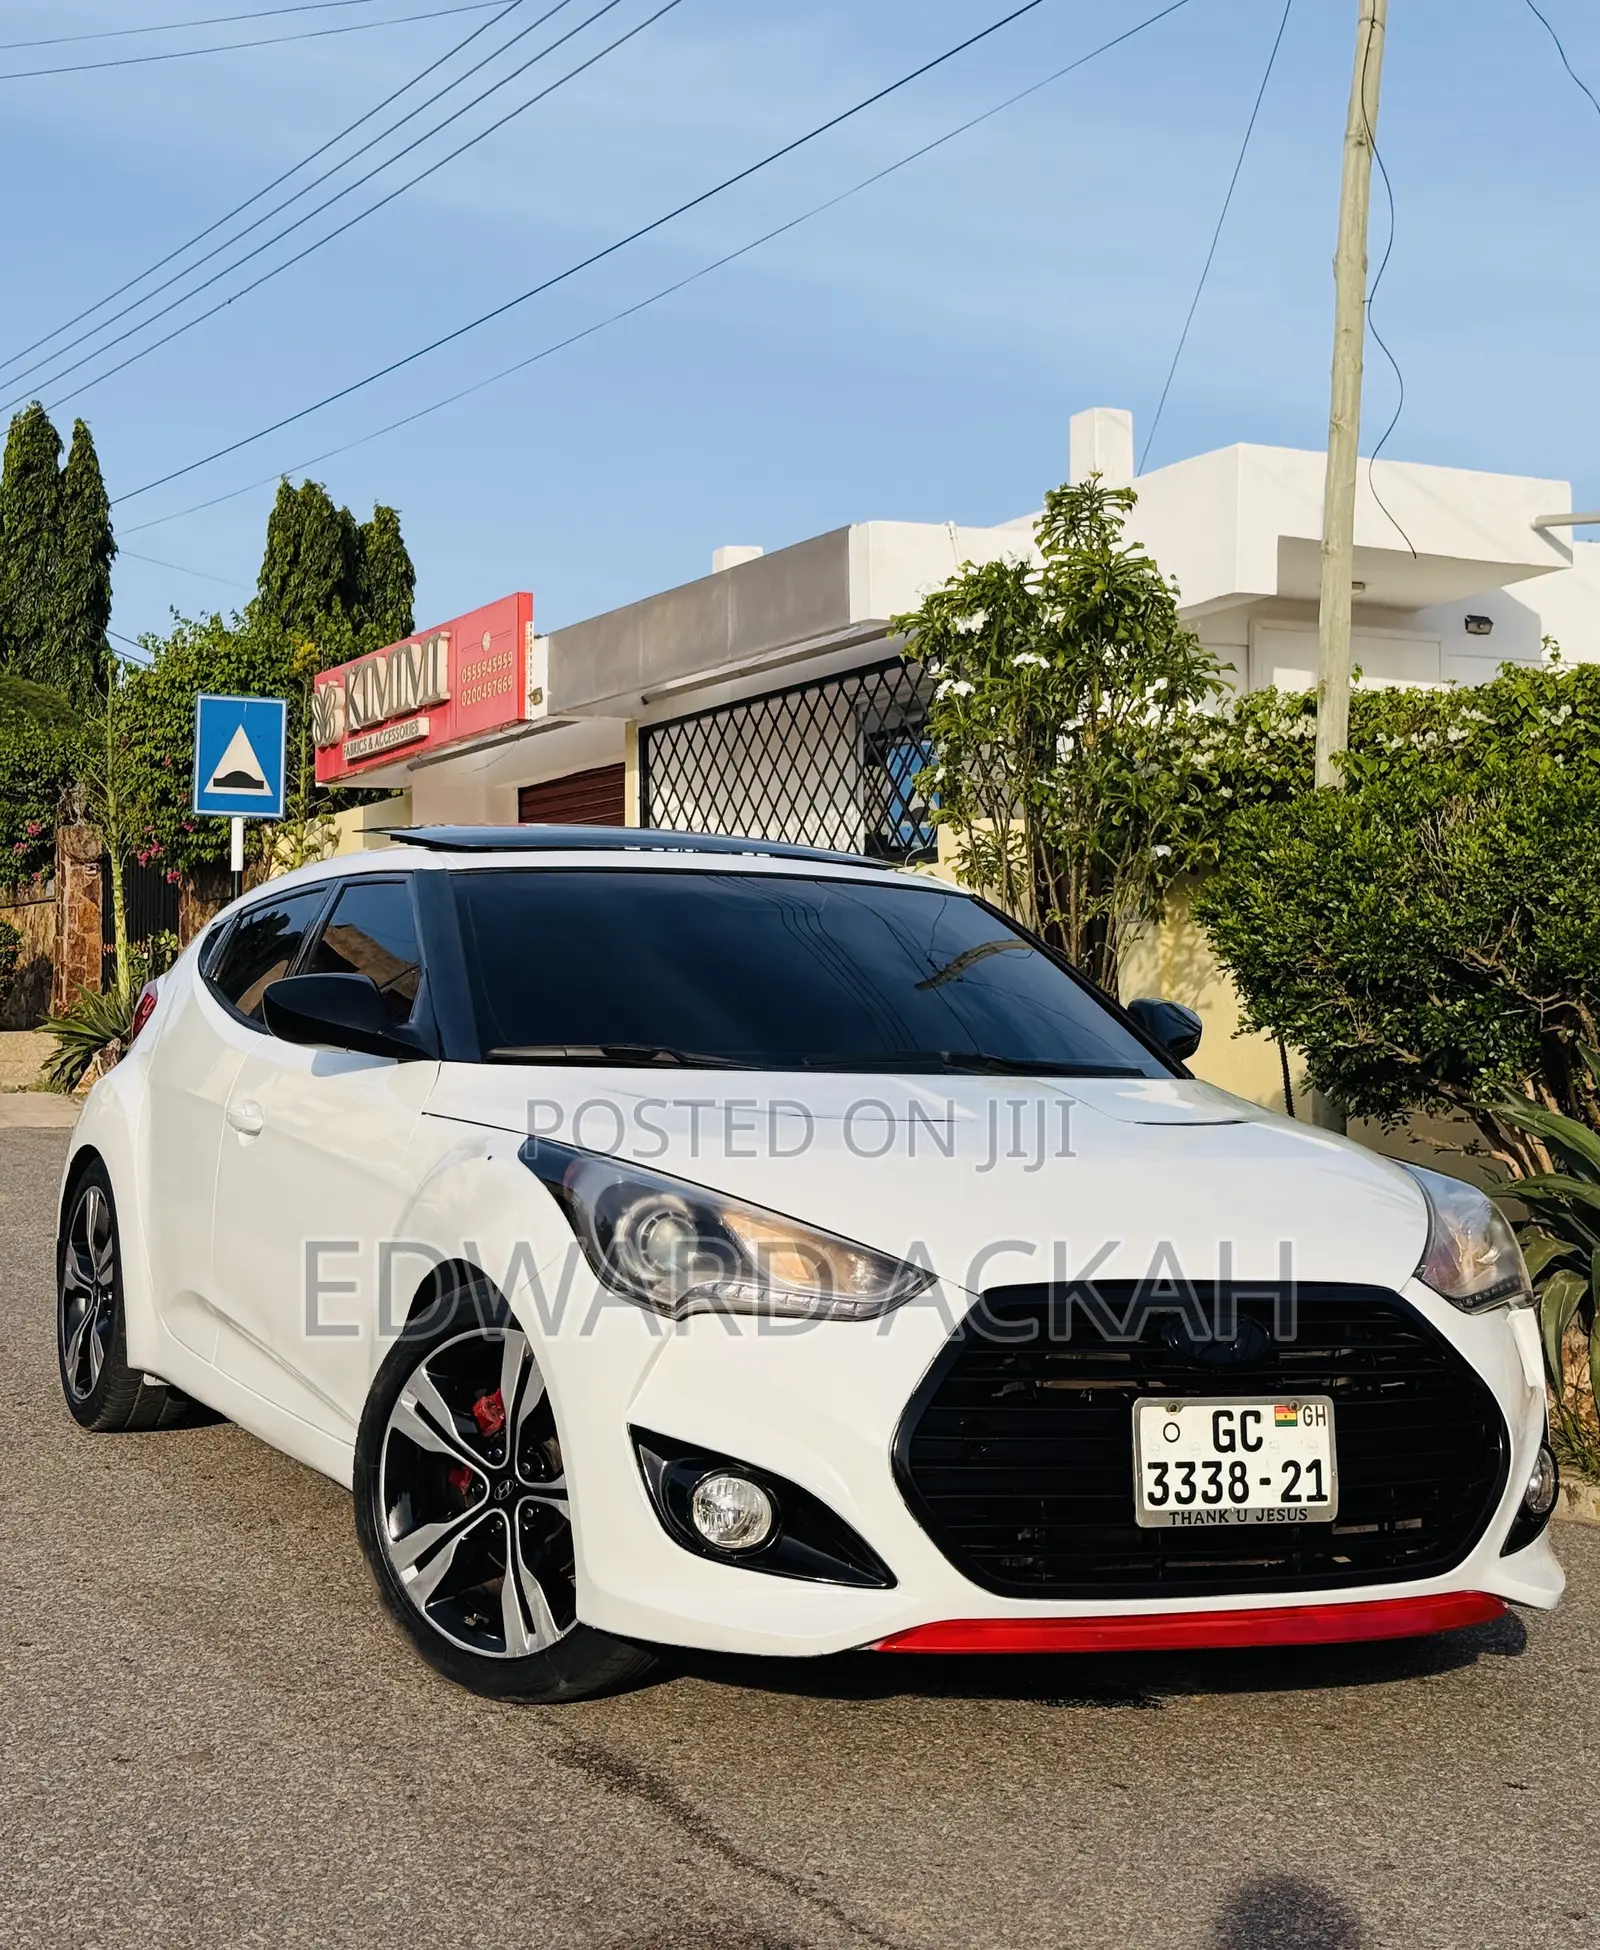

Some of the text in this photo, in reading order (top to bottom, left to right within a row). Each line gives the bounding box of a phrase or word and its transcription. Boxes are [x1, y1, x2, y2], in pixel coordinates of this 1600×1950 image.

[461, 650, 513, 684] 0555945959
[461, 674, 513, 707] 0200457669
[343, 719, 420, 758] FABRICS & ACCESSORIES
[1212, 1405, 1326, 1453] GC GH
[1169, 1508, 1308, 1526] THANK U JESUS
